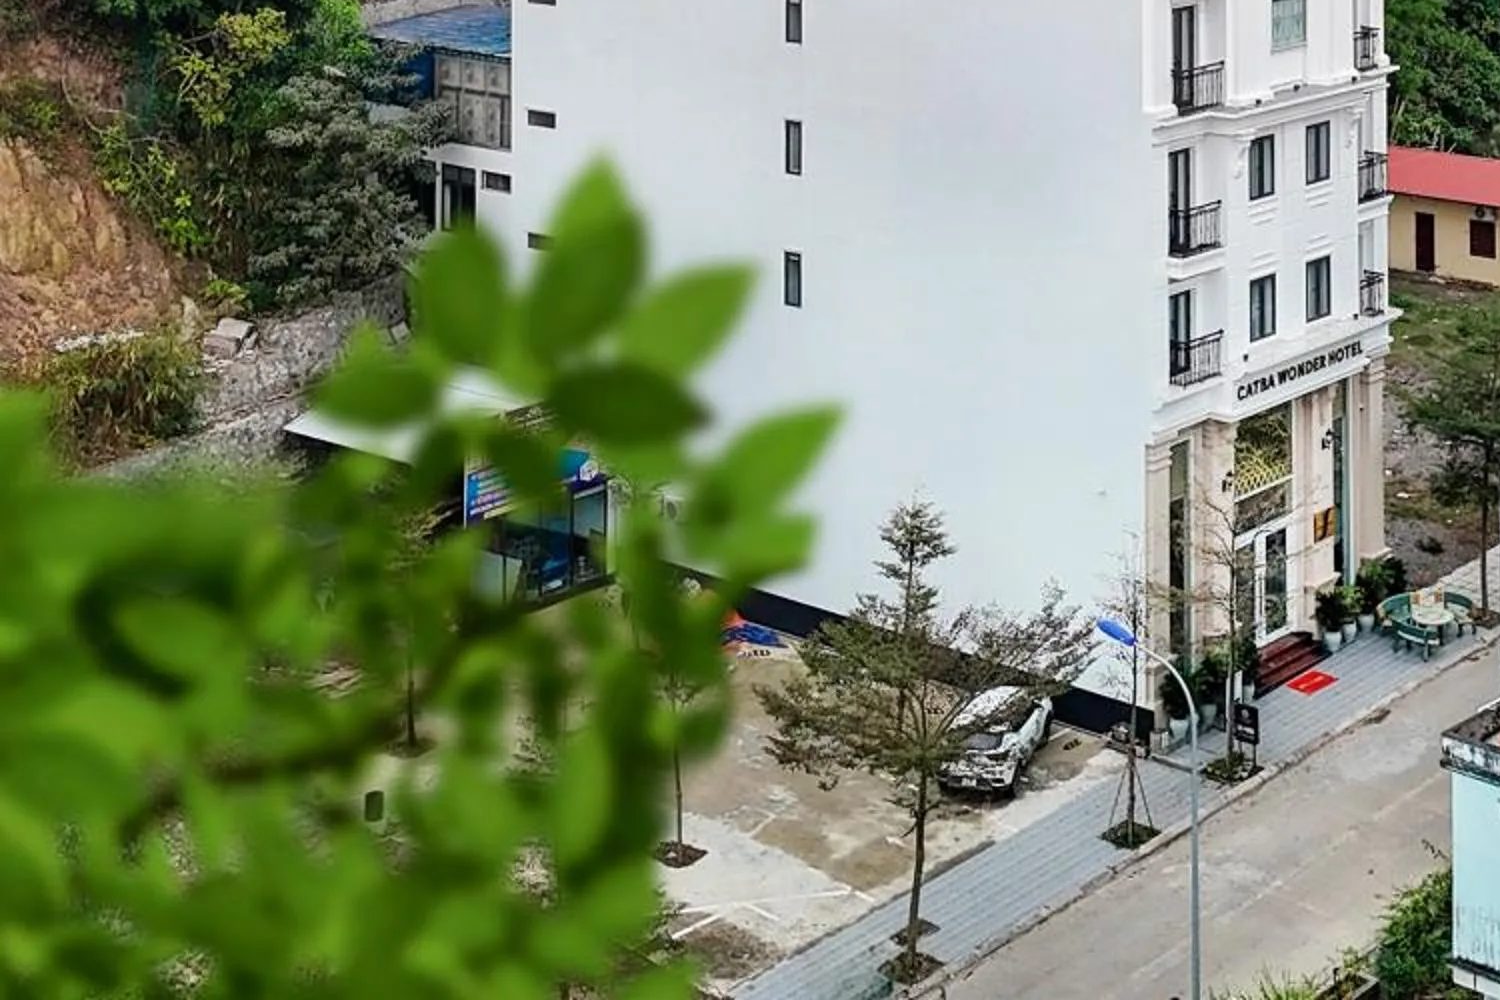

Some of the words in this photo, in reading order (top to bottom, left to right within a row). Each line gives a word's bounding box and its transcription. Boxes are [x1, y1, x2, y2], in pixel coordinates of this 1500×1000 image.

[1237, 374, 1276, 401] CATBA
[1277, 355, 1327, 384] WONDER
[1328, 340, 1363, 366] HOTEL
